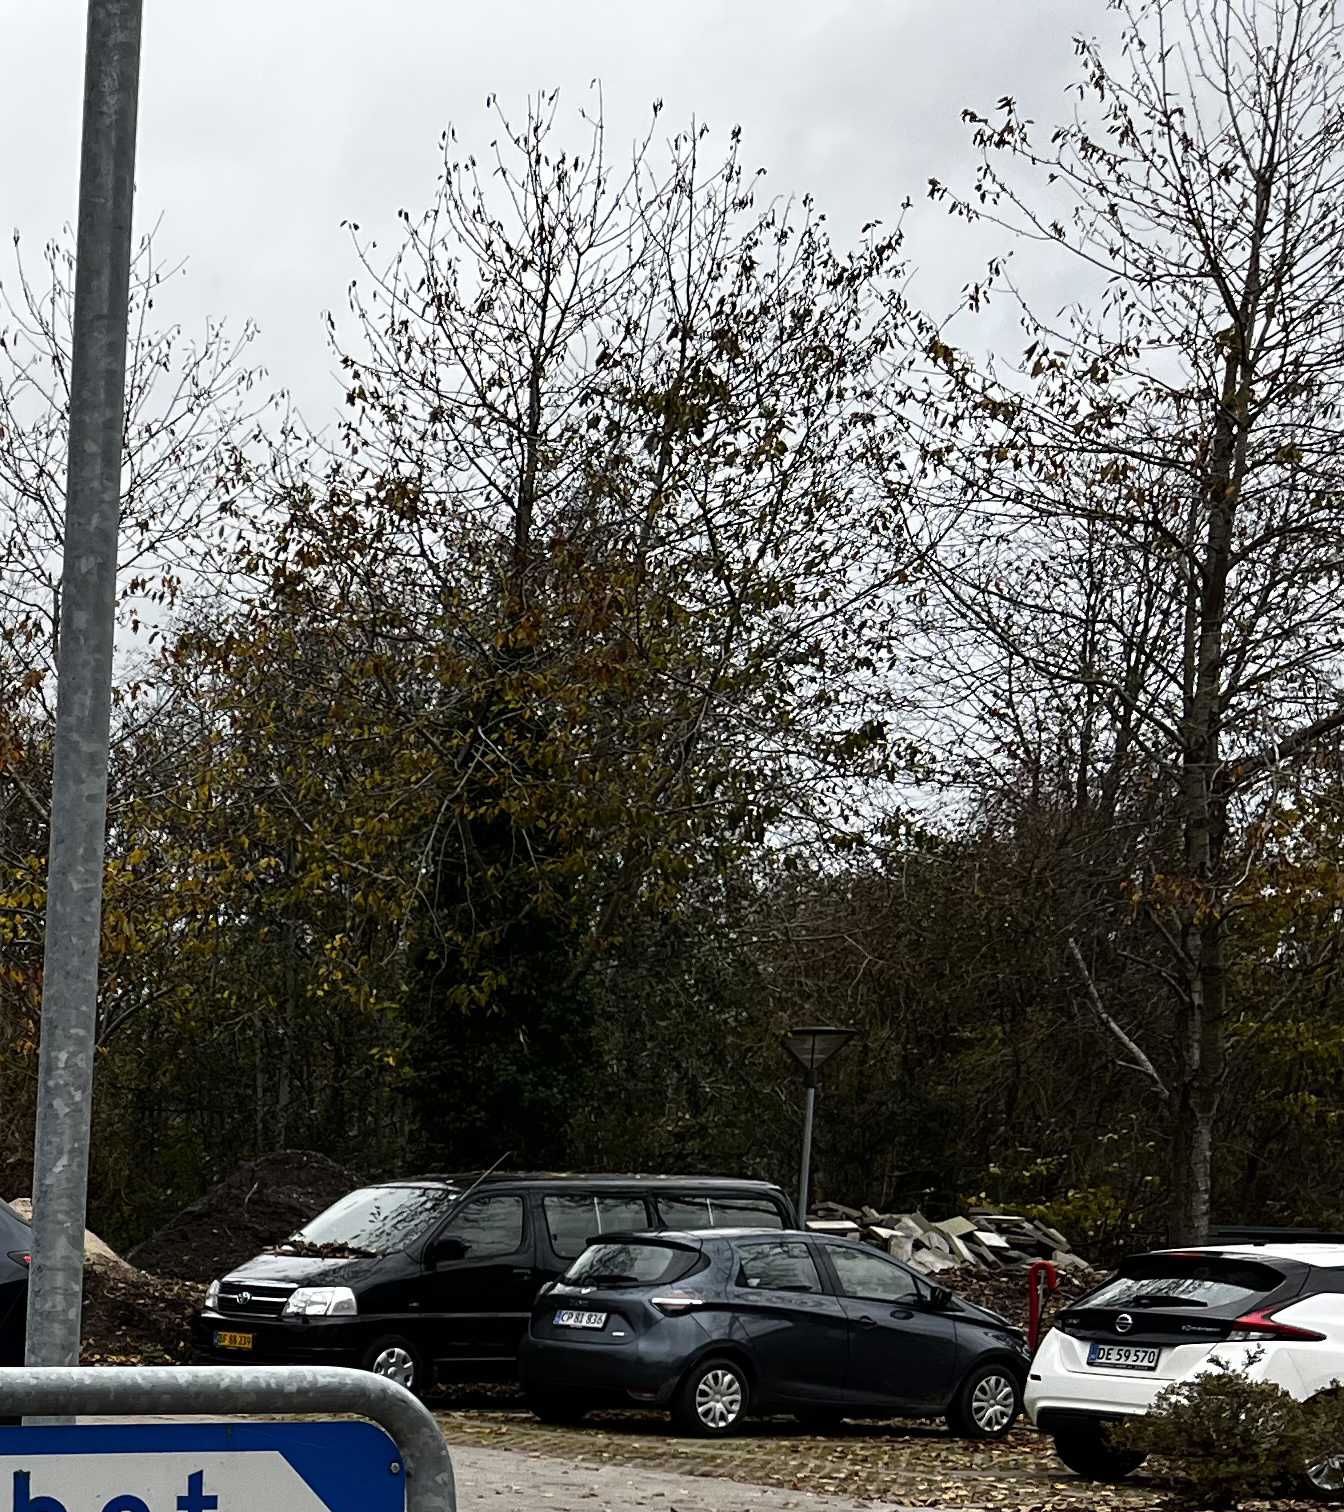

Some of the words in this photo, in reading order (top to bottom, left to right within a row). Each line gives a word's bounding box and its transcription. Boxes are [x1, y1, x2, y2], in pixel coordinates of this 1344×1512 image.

[1097, 1347, 1114, 1361] DE
[1115, 1349, 1131, 1362] 59
[1132, 1350, 1156, 1364] 570
